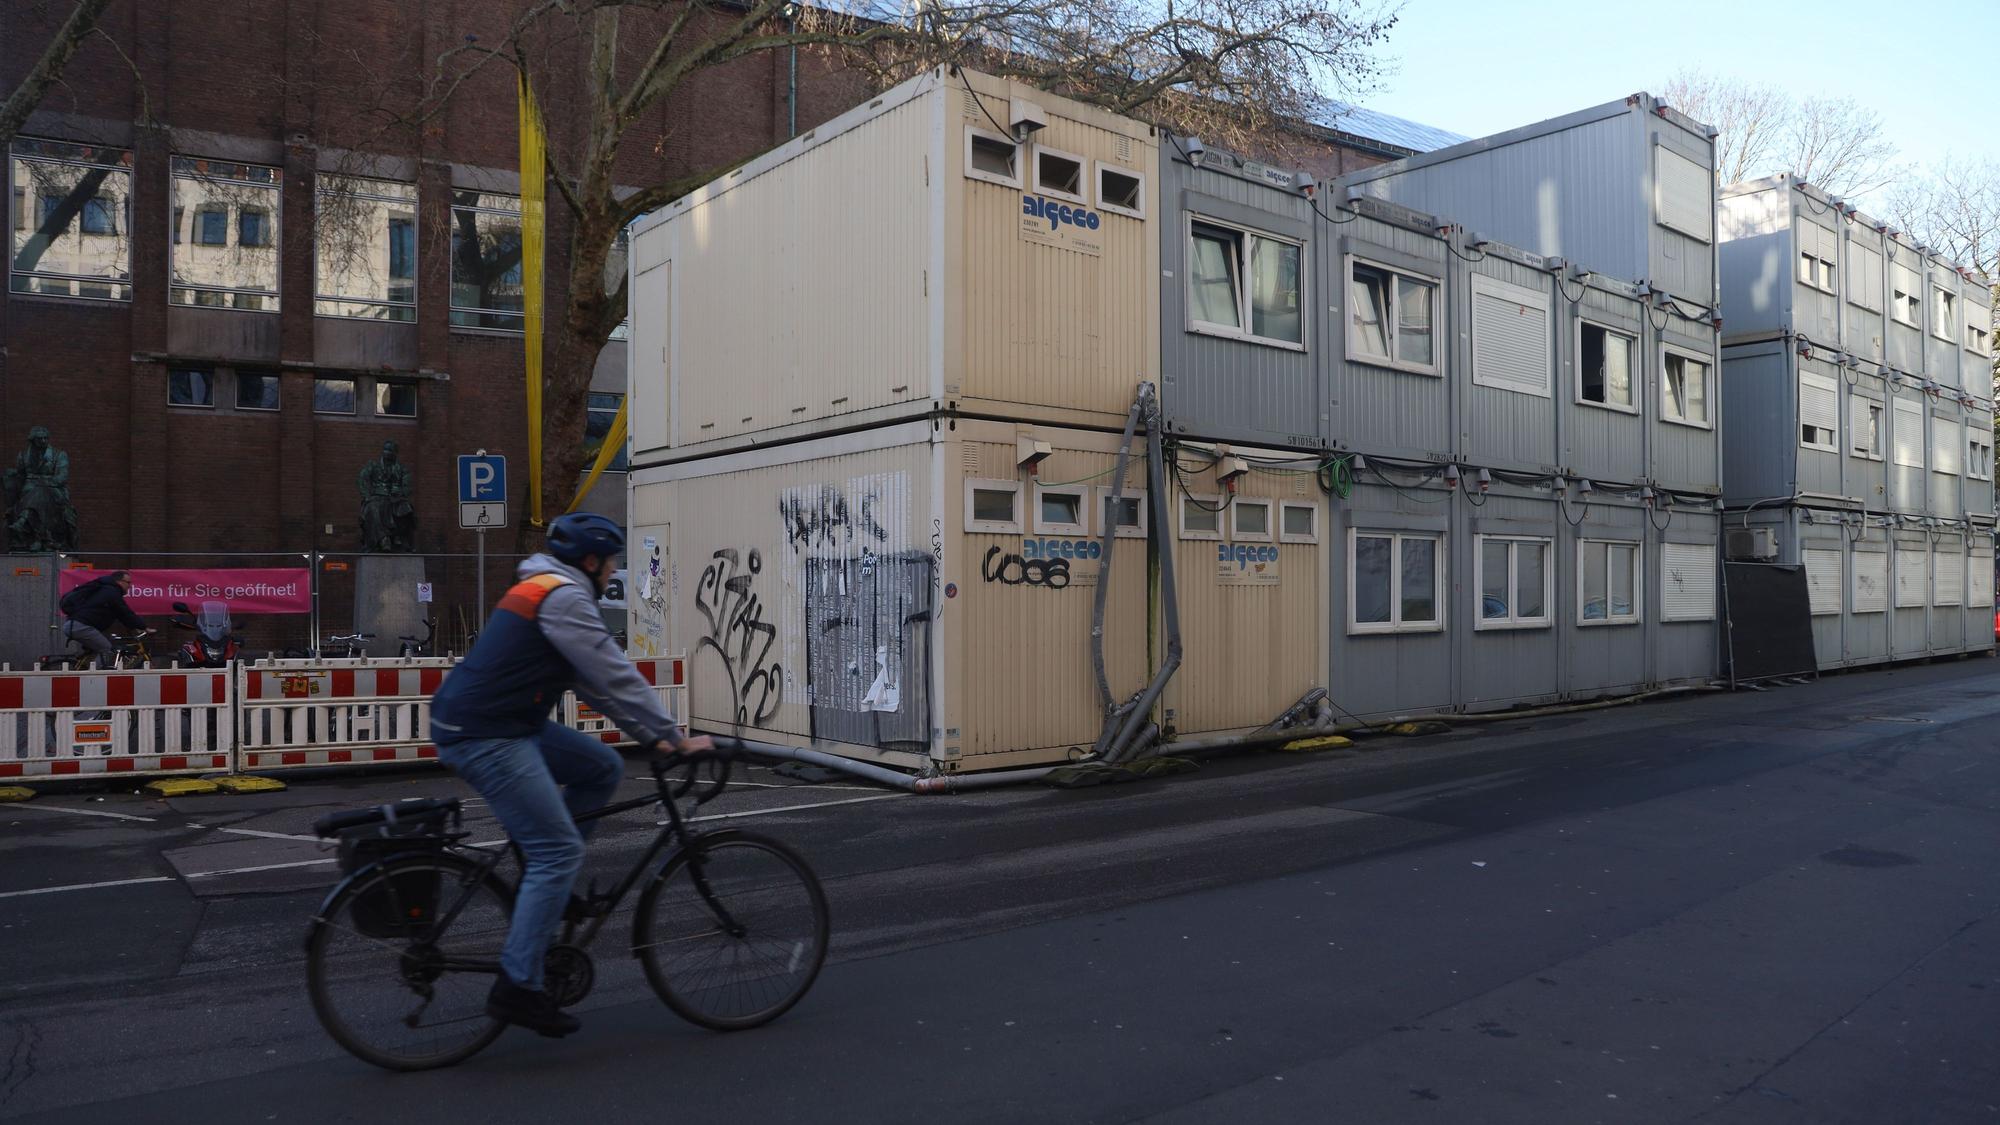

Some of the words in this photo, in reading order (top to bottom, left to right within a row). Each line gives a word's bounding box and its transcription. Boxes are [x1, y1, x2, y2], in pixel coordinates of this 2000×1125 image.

[1023, 195, 1099, 231] algeco
[470, 462, 495, 498] P
[1218, 543, 1278, 571] algeco
[124, 584, 163, 598] aben
[167, 583, 190, 598] für
[195, 583, 221, 598] Sie
[225, 583, 297, 600] geöffnet!
